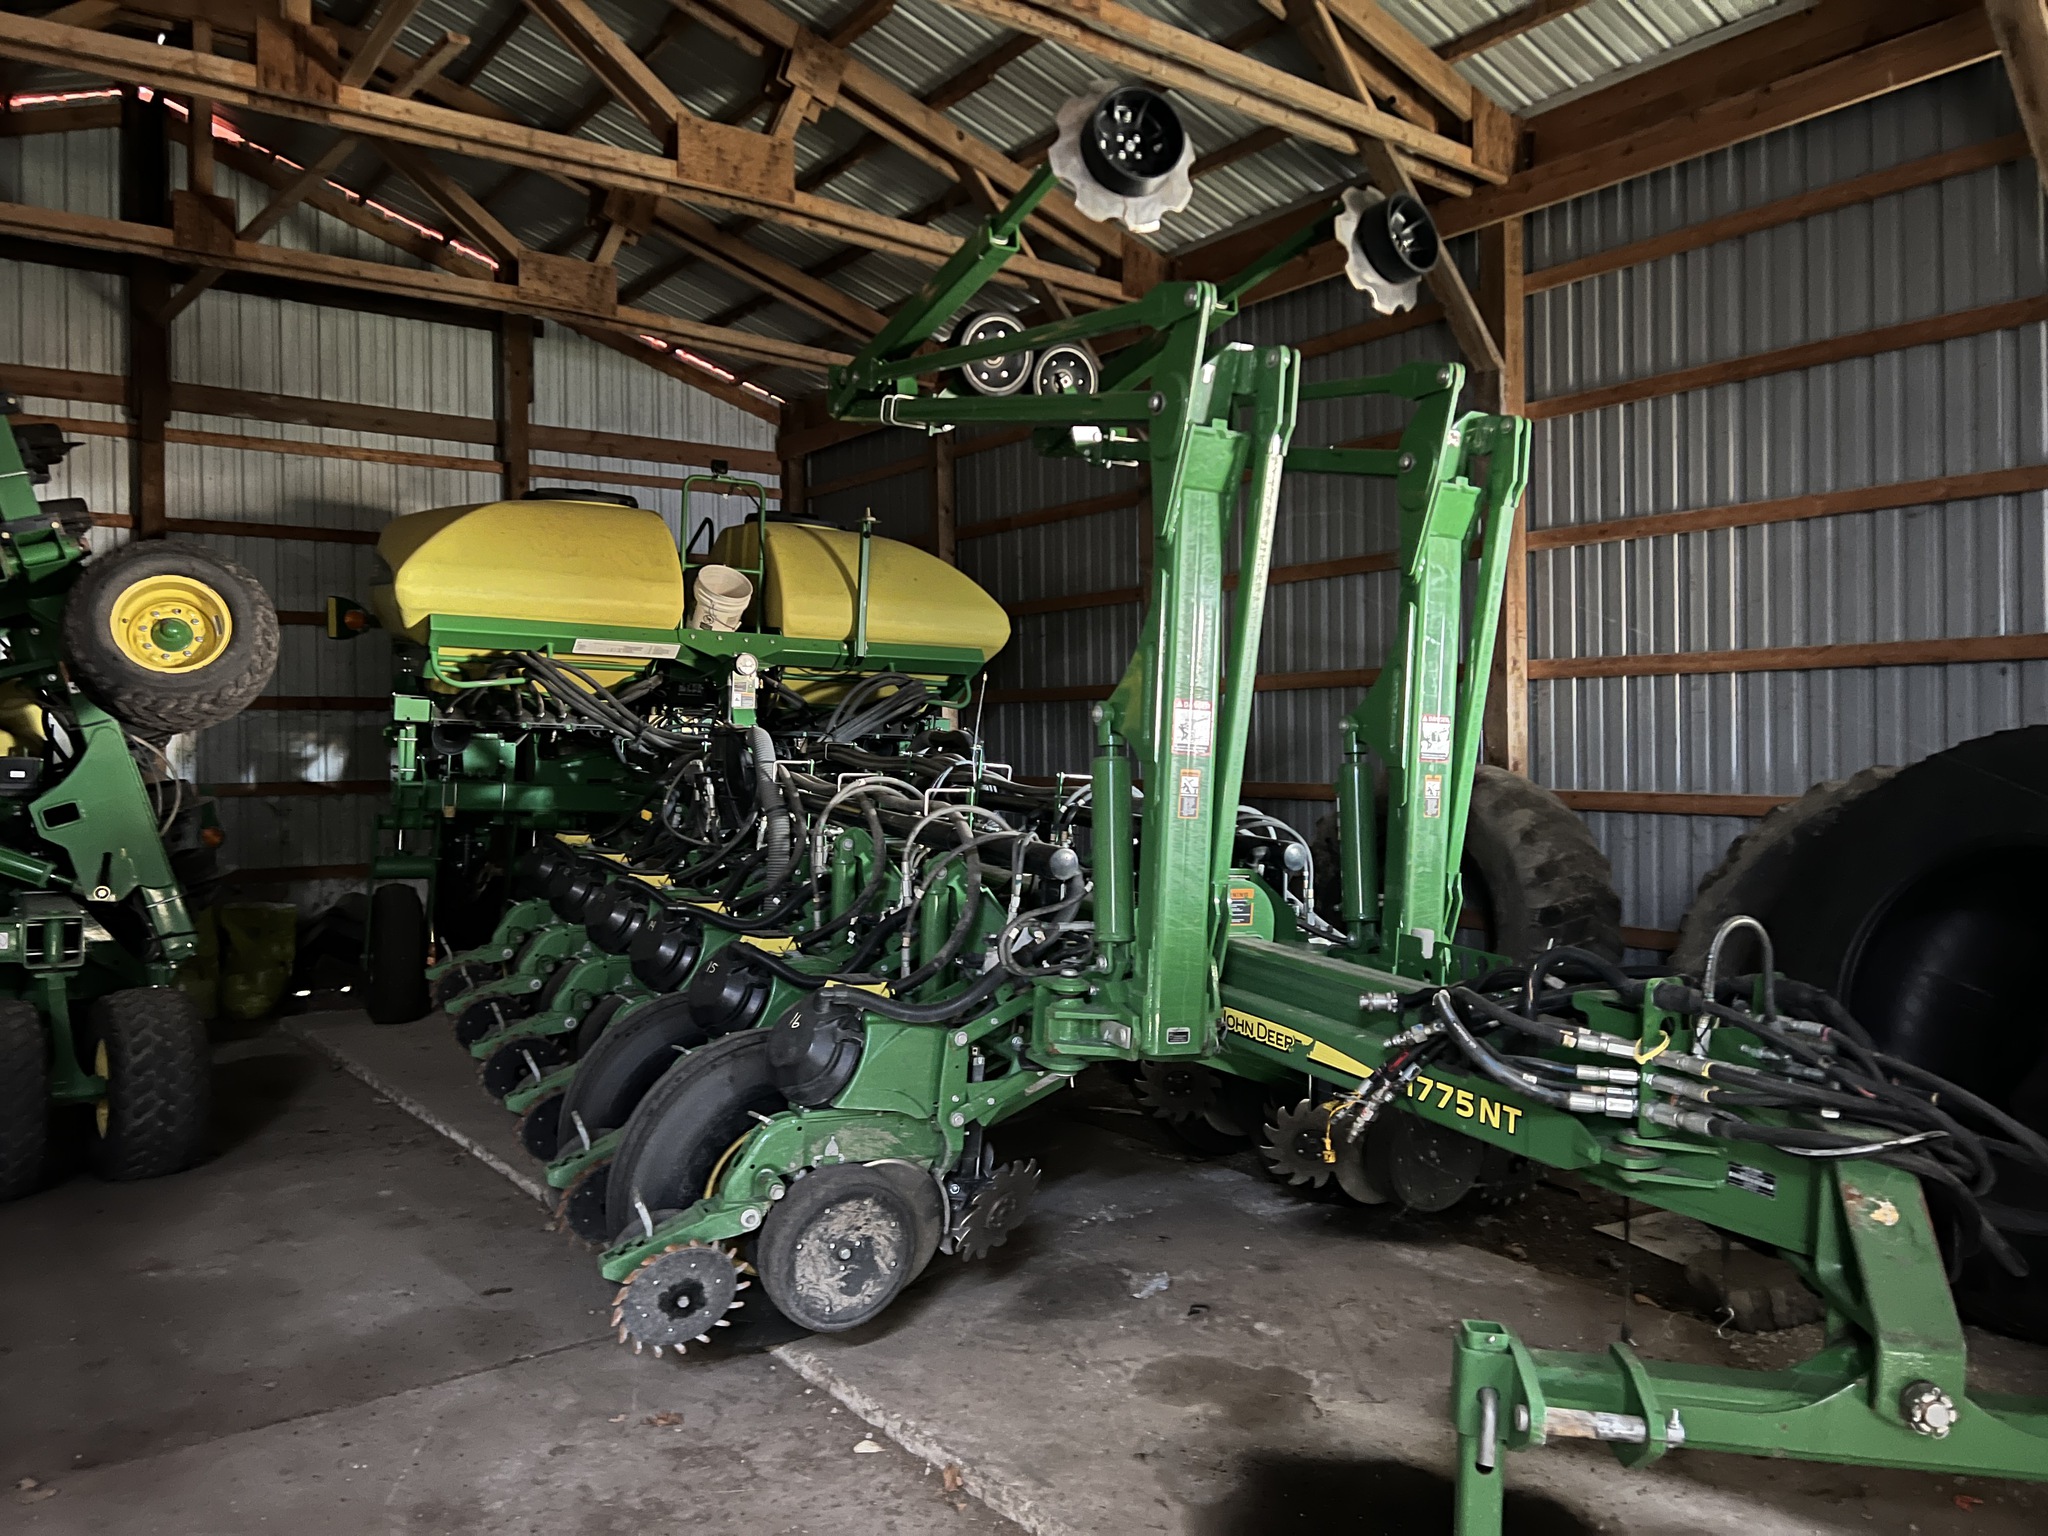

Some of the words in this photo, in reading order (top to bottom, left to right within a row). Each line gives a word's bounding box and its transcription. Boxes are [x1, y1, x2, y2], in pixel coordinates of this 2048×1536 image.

[706, 961, 719, 974] 15
[789, 1012, 802, 1029] 16
[1256, 1022, 1302, 1048] DEER
